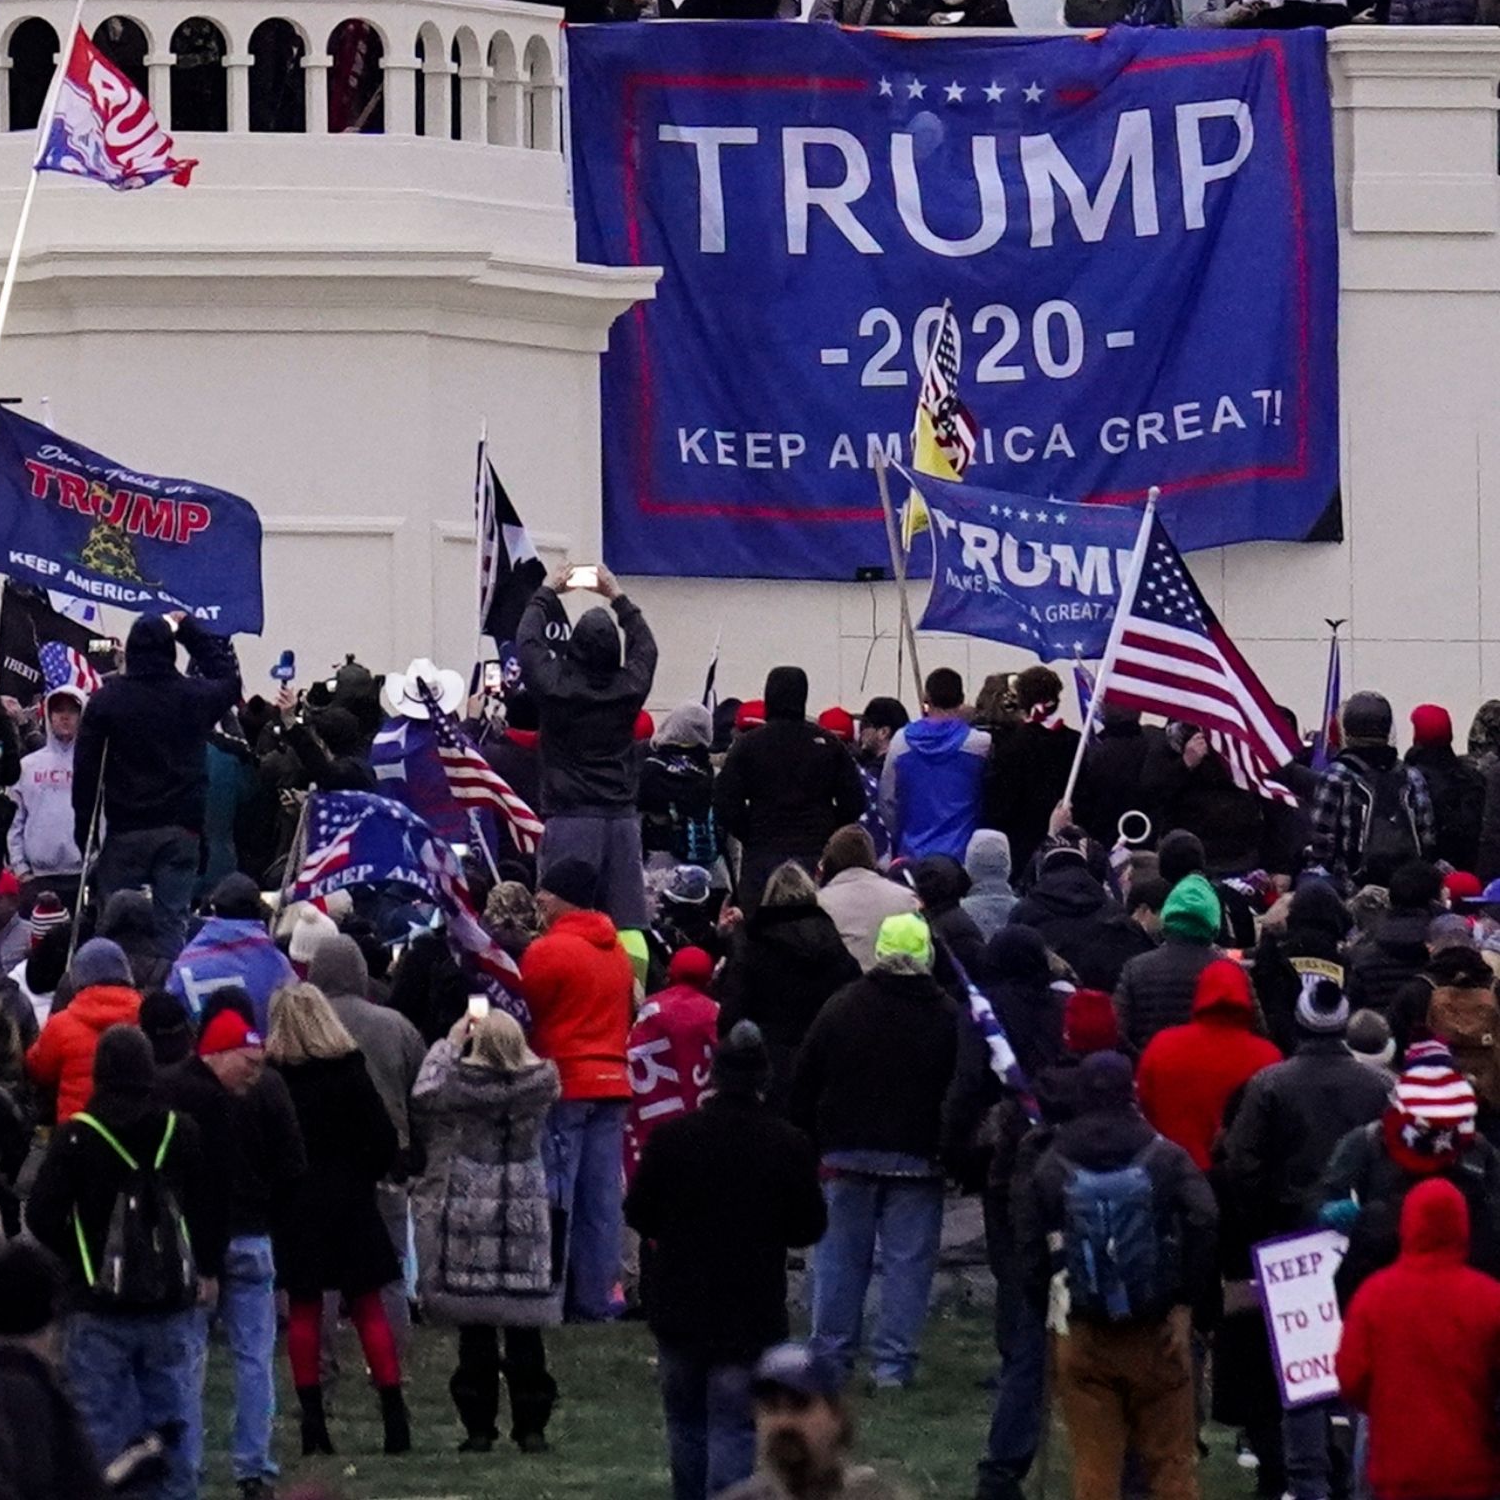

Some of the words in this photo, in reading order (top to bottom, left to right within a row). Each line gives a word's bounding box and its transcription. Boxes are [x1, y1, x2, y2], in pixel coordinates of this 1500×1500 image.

[658, 98, 1254, 258] TRUMP
[678, 426, 807, 470] KEEP
[828, 422, 1077, 470] AMICA
[1100, 389, 1283, 455] GREAT!
[23, 457, 213, 545] TRUMP
[8, 550, 62, 577] KEEP
[64, 568, 154, 603] AMERICA
[156, 590, 223, 621] GAT
[1045, 602, 1104, 624] GREAT
[309, 863, 374, 898] KEEP
[1264, 1251, 1323, 1285] KEEP
[1276, 1309, 1309, 1334] TO
[1318, 1301, 1335, 1323] U
[1284, 1353, 1332, 1385] CON
